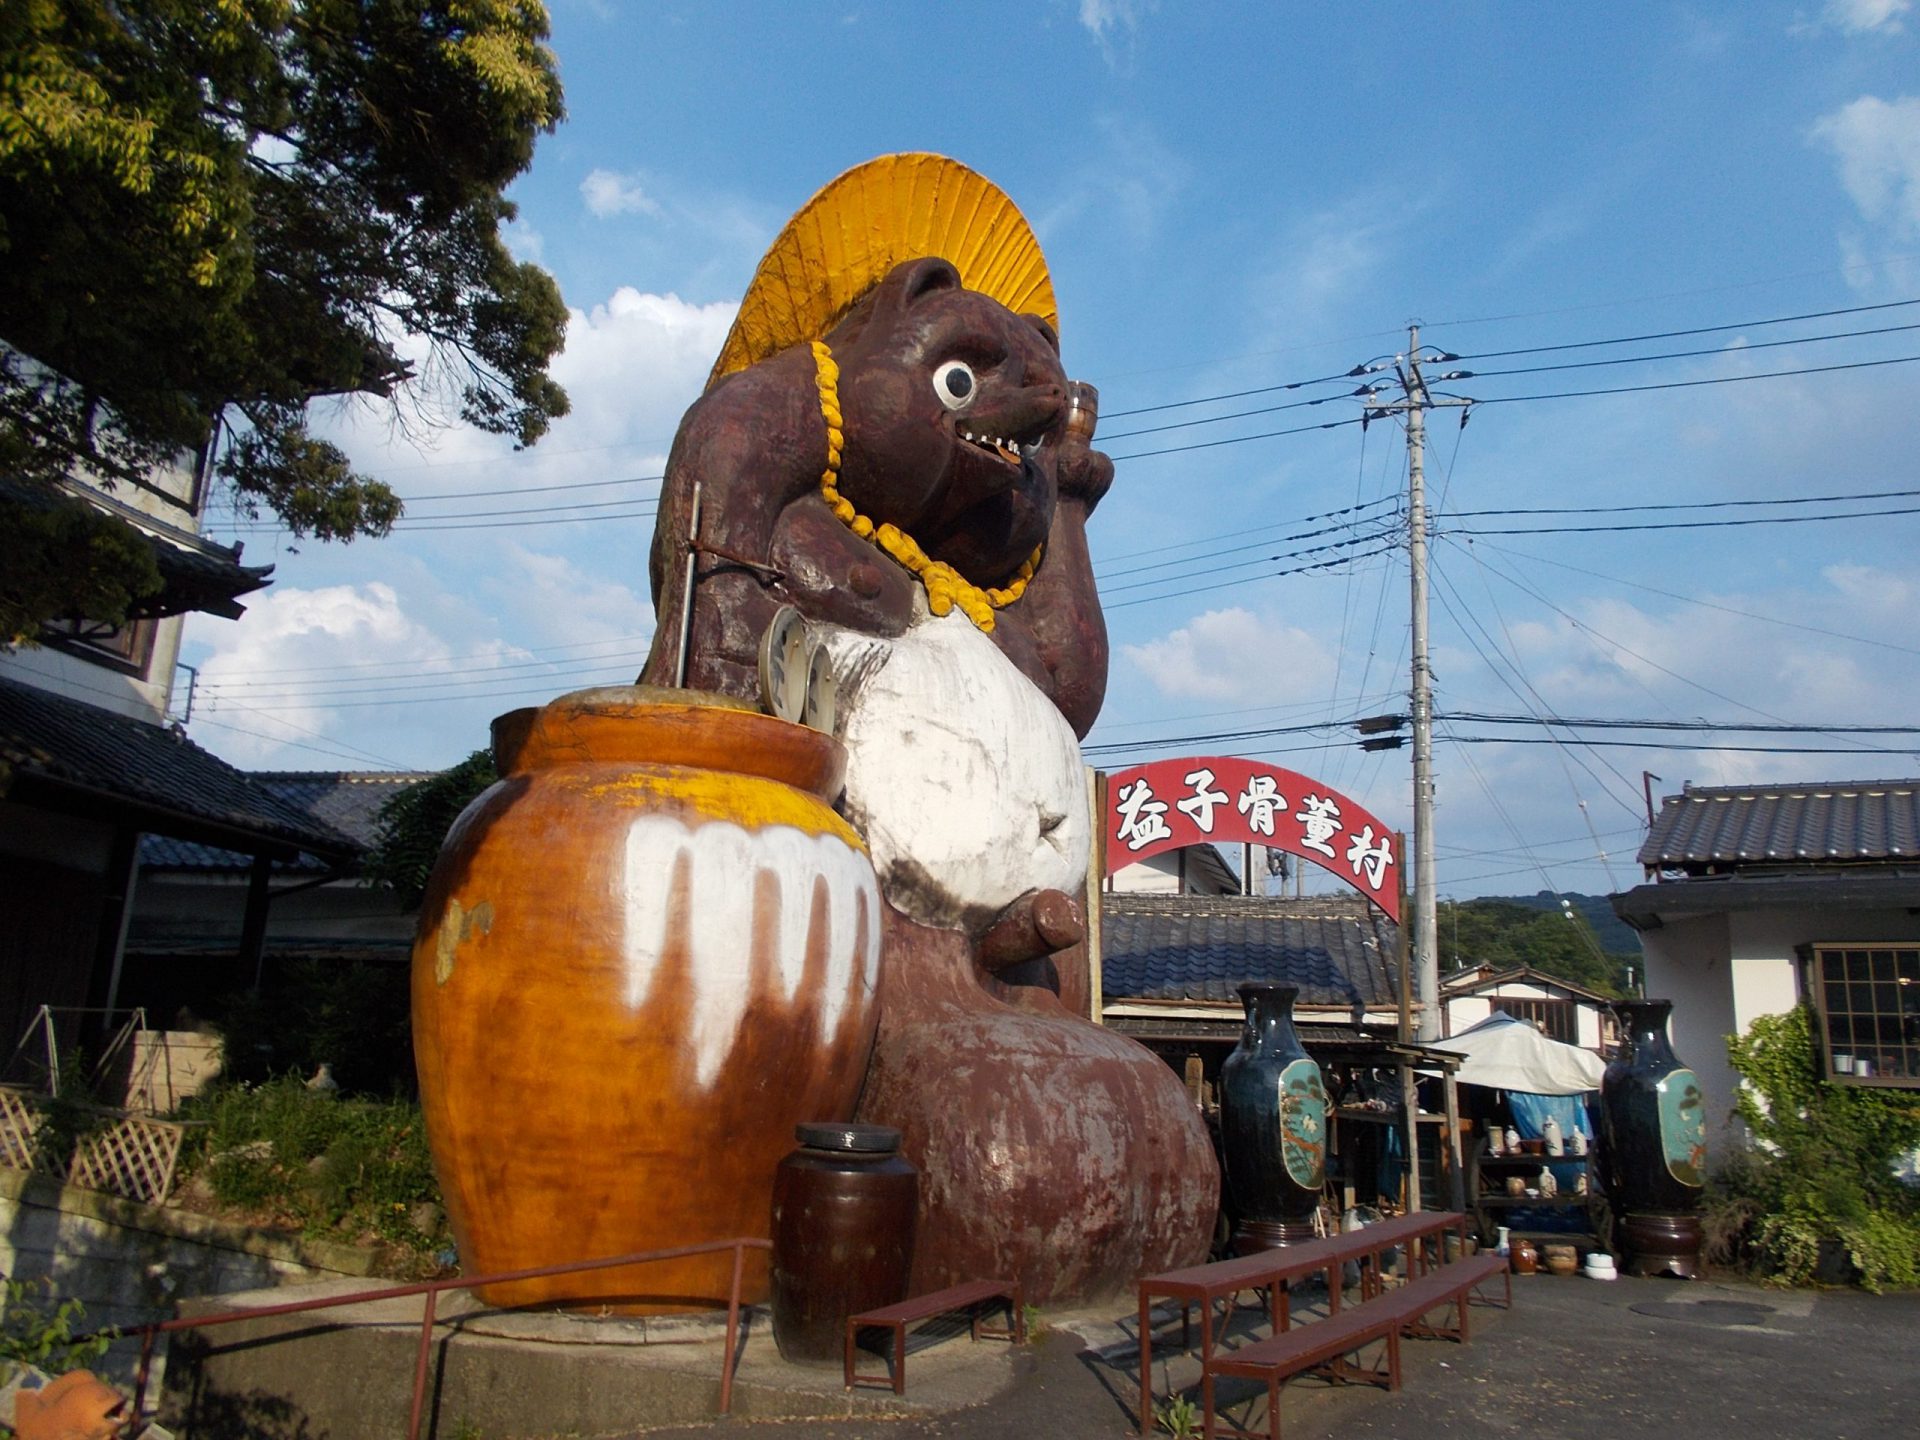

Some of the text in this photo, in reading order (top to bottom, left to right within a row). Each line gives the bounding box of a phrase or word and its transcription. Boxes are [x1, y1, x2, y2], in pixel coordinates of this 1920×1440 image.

[1116, 768, 1393, 890] 益子骨董村
